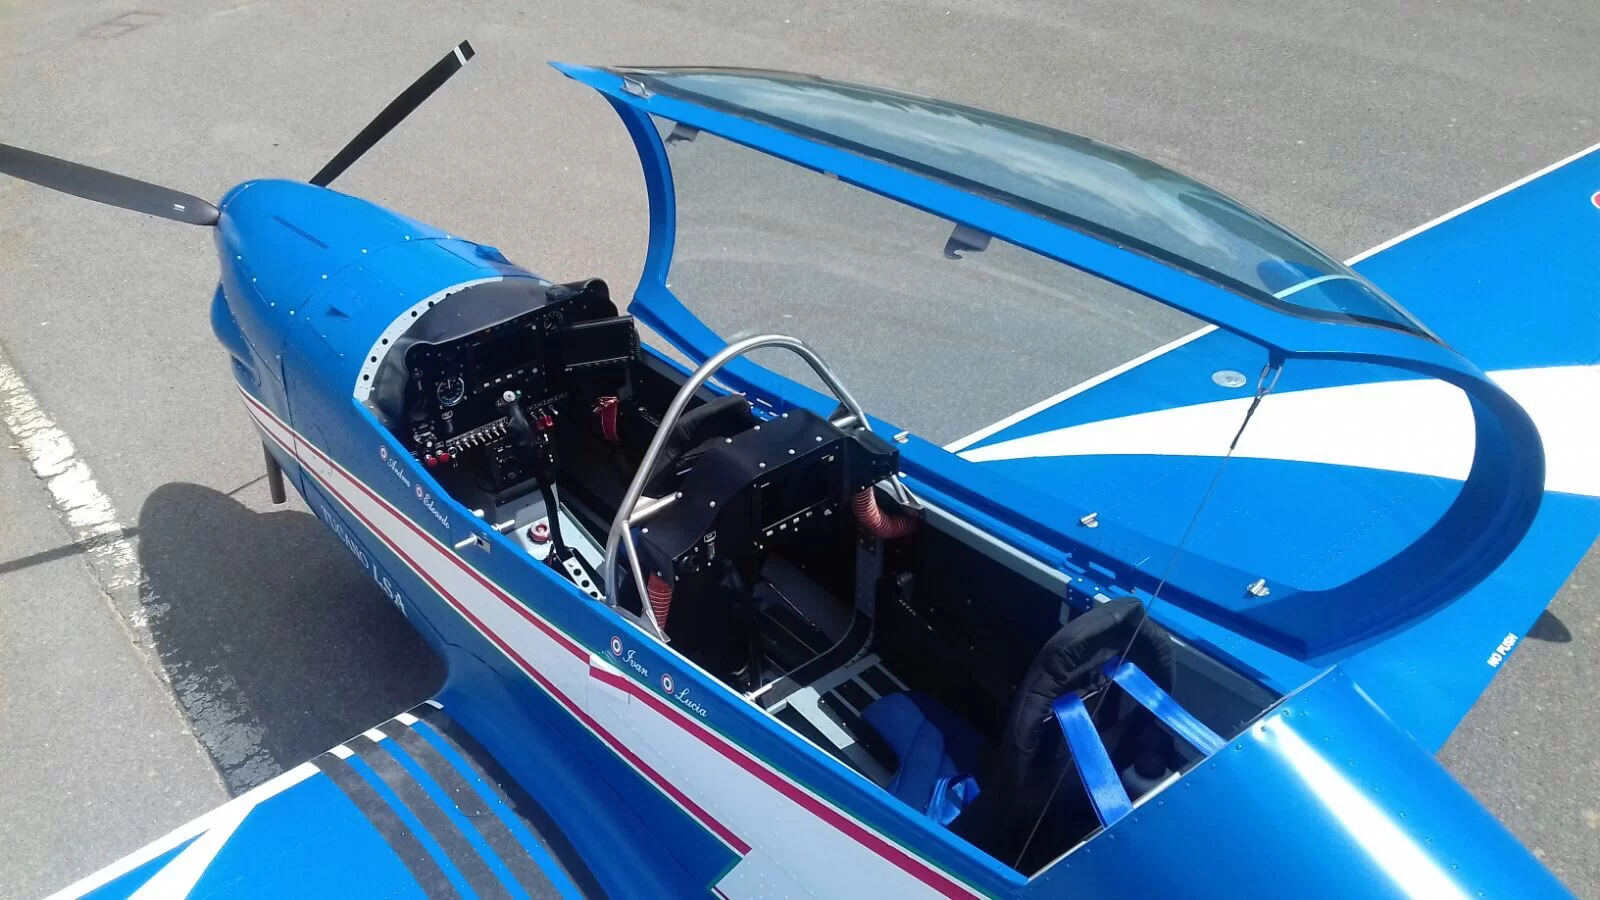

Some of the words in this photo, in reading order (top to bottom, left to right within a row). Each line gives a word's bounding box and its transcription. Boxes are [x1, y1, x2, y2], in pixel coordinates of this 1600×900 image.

[387, 459, 411, 488] Andrea
[623, 650, 648, 677] Ivan
[1487, 652, 1502, 668] NO
[1496, 632, 1518, 655] PUSH
[675, 688, 707, 717] Lucia
